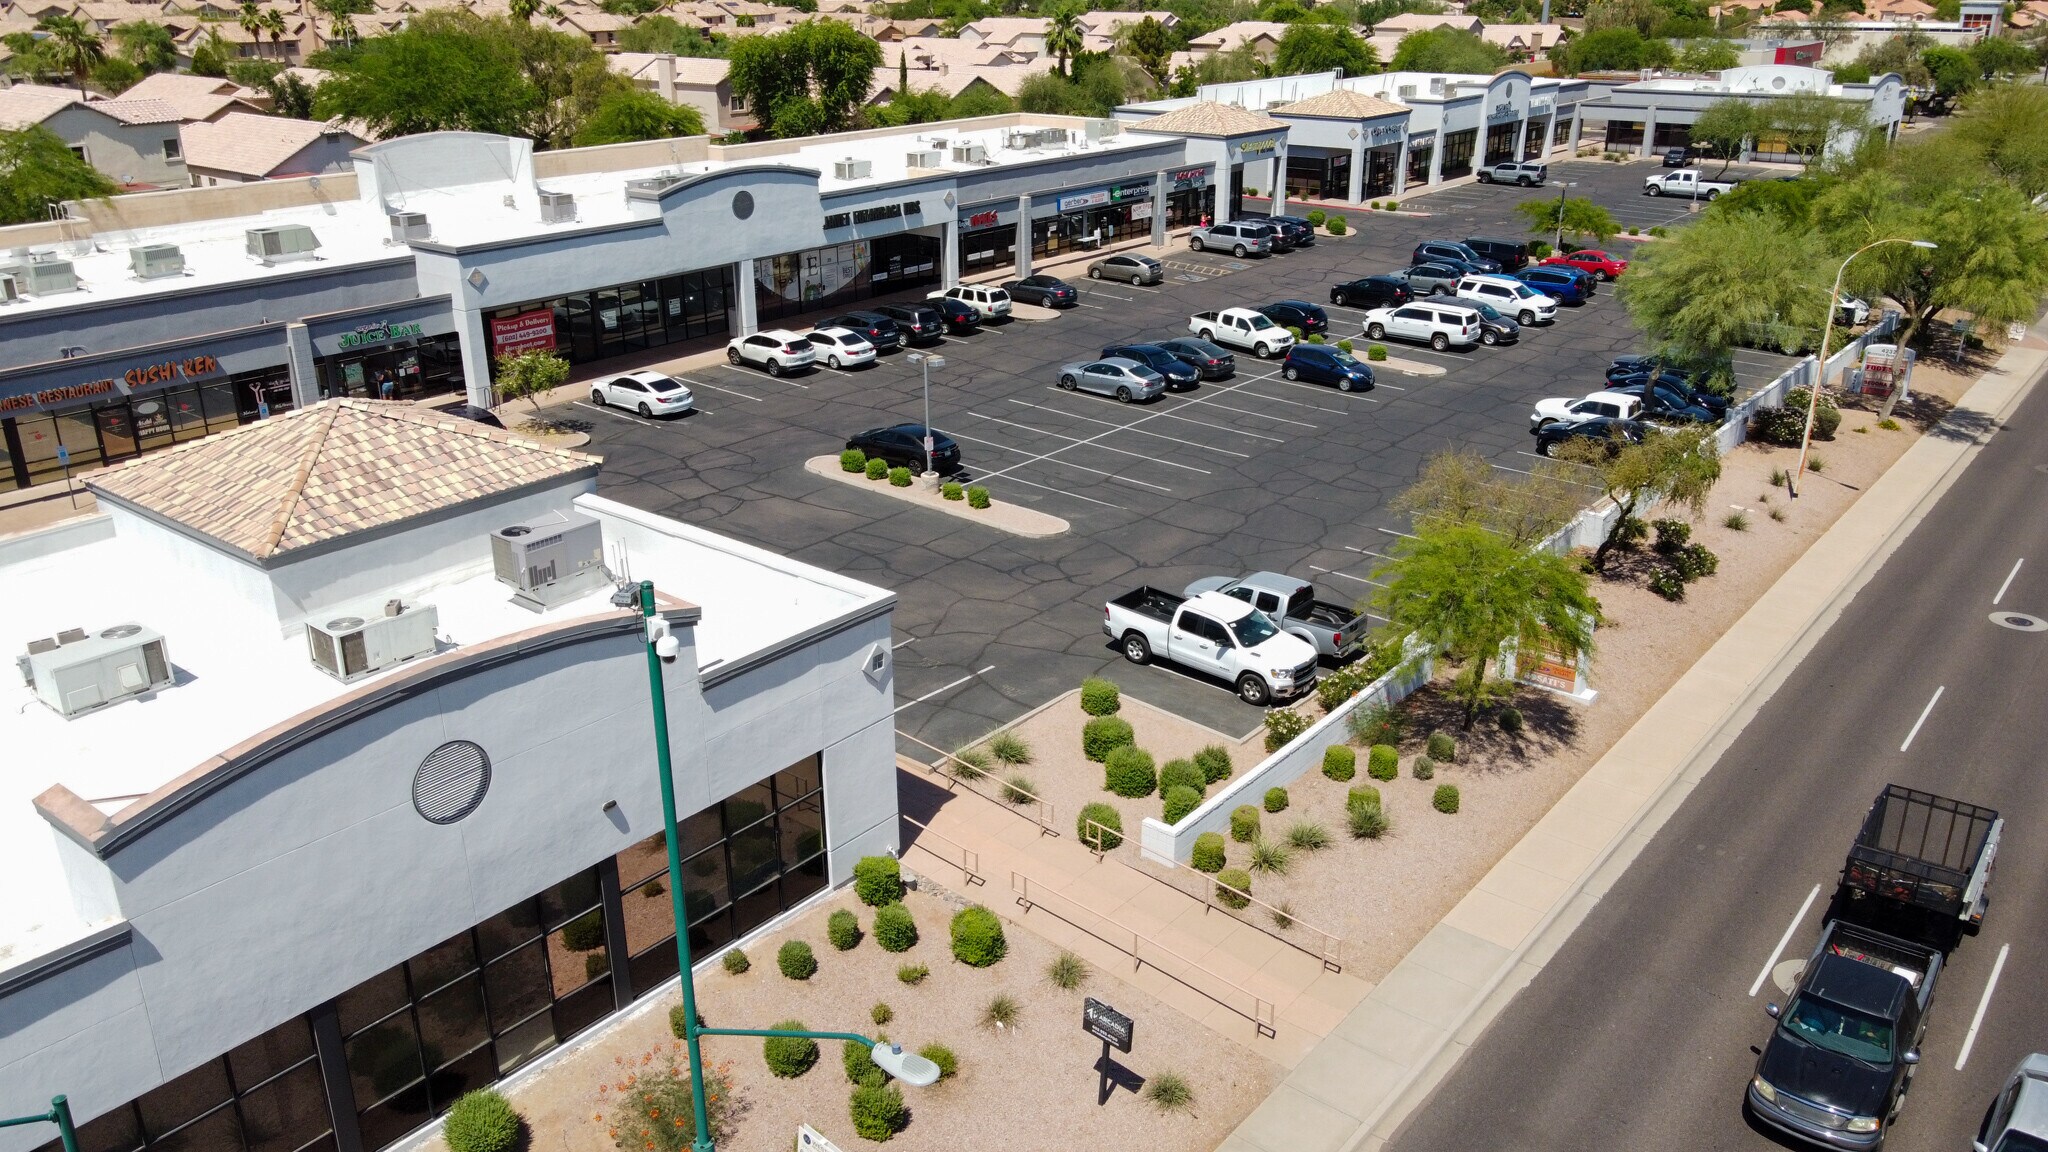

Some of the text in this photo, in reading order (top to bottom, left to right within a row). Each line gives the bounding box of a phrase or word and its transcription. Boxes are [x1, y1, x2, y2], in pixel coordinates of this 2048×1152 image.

[1113, 185, 1150, 197] enterprise
[497, 323, 518, 332] Pickup
[525, 317, 549, 326] Delivery
[339, 323, 422, 348] JUICE BAR
[125, 355, 217, 387] SUSHI KEN
[38, 379, 115, 403] RESTAURANT
[1099, 1015, 1125, 1033] ARCADIA
